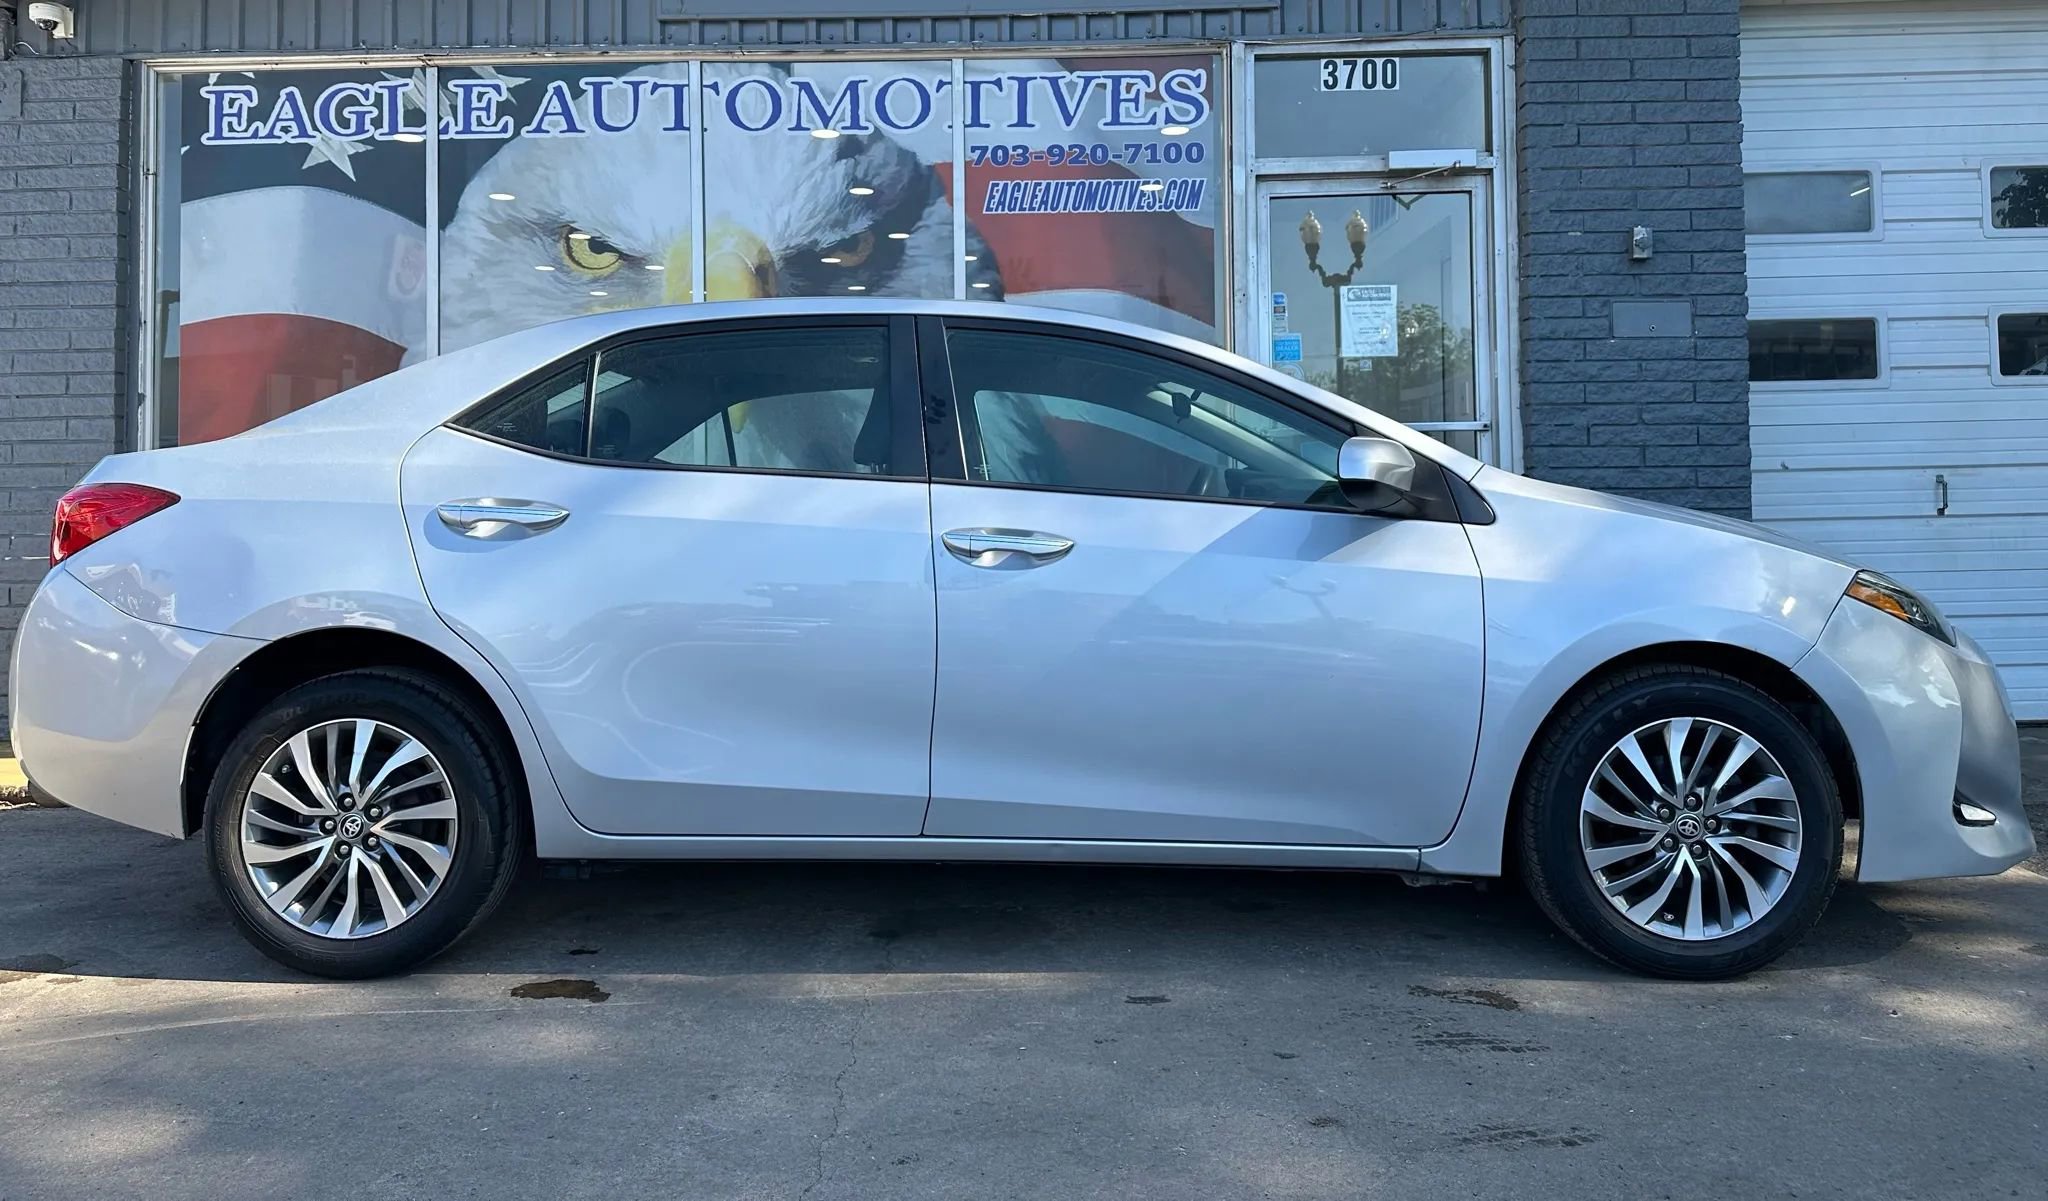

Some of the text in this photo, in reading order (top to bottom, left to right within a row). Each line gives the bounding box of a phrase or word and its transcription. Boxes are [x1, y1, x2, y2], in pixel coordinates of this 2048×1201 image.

[1322, 58, 1397, 90] 3700
[201, 70, 1210, 144] EAGLE AUTOMOTIVES
[970, 142, 1205, 167] 703-920-7100
[984, 177, 1206, 214] EAGLEAUTOMOTIVES.COM
